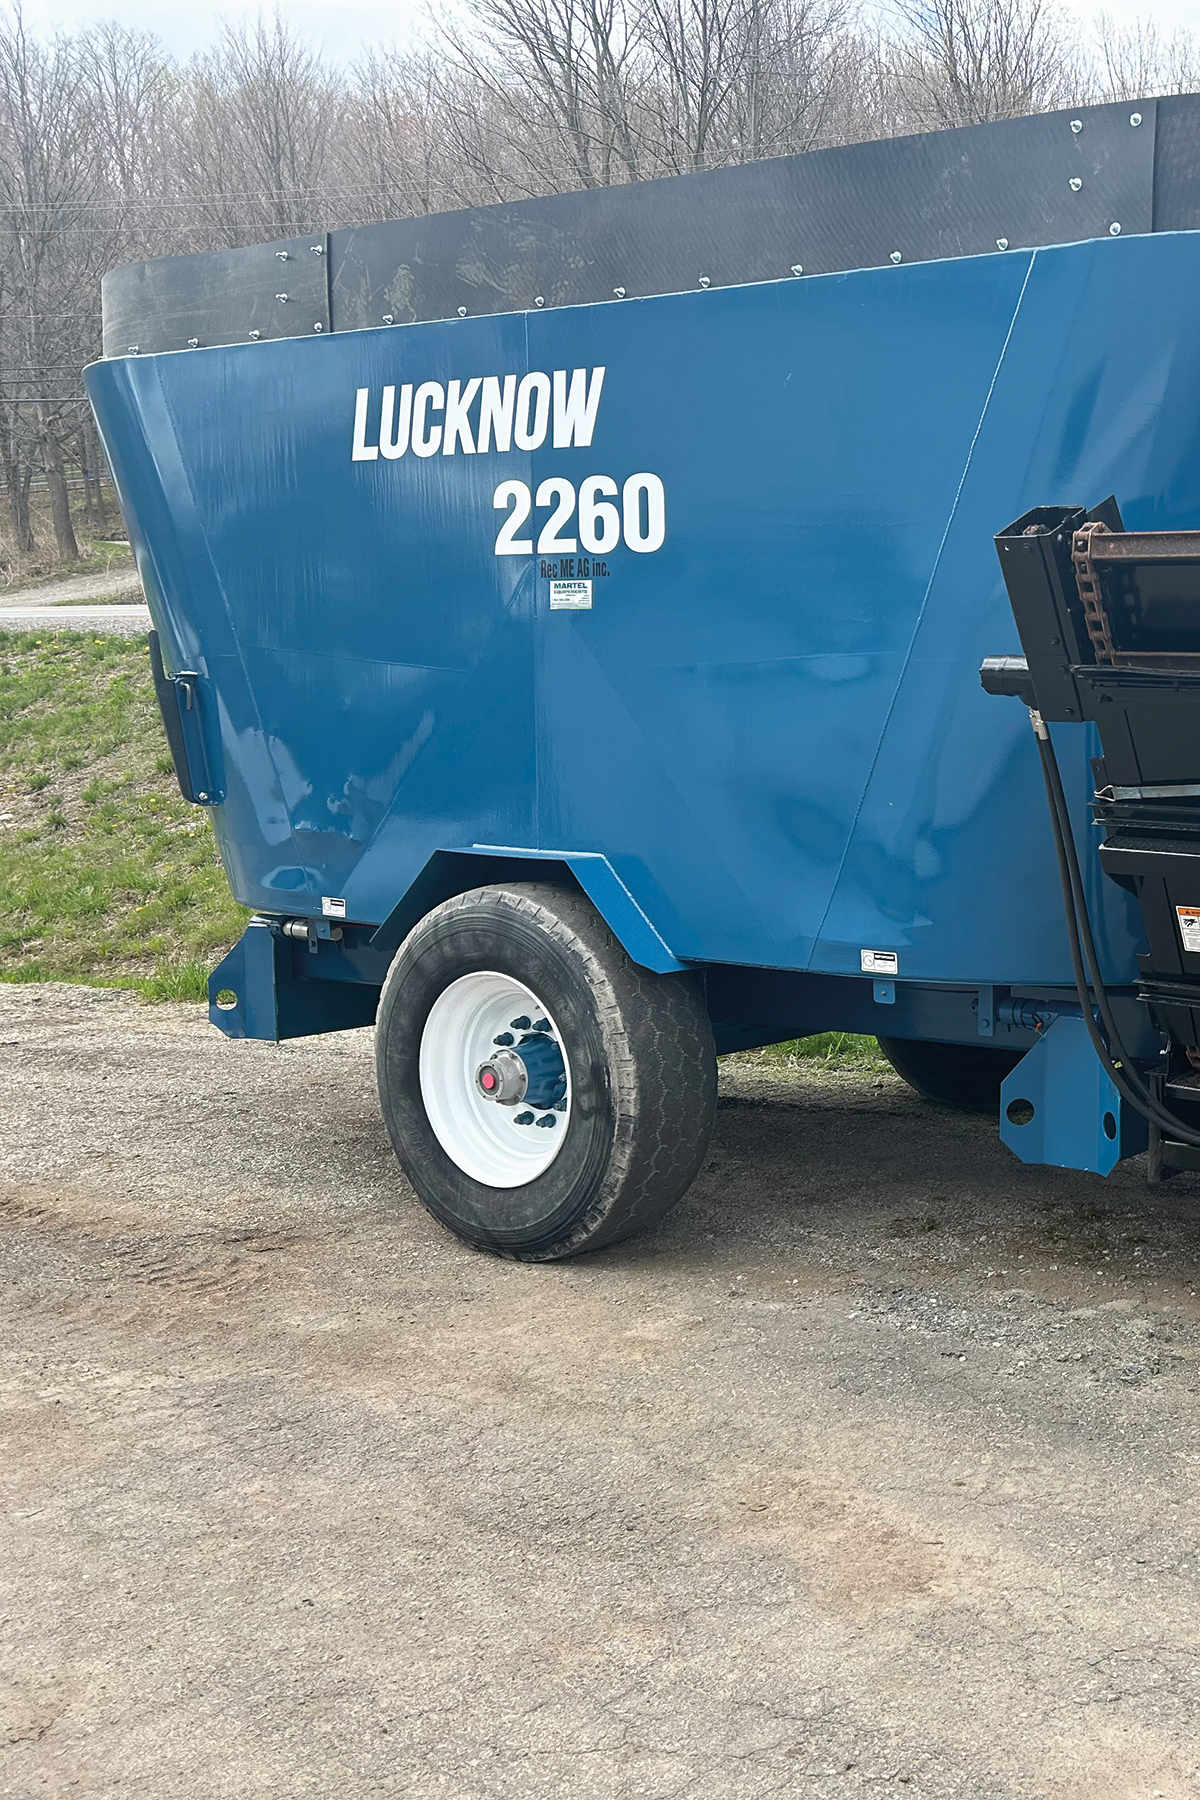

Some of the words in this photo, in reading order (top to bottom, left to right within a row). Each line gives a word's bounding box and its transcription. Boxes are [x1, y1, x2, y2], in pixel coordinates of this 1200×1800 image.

[352, 366, 606, 461] LUCKNOW
[493, 472, 666, 555] 2260
[541, 560, 558, 578] Rec
[560, 559, 574, 577] ME
[577, 558, 590, 577] AG
[592, 558, 610, 576] inc.
